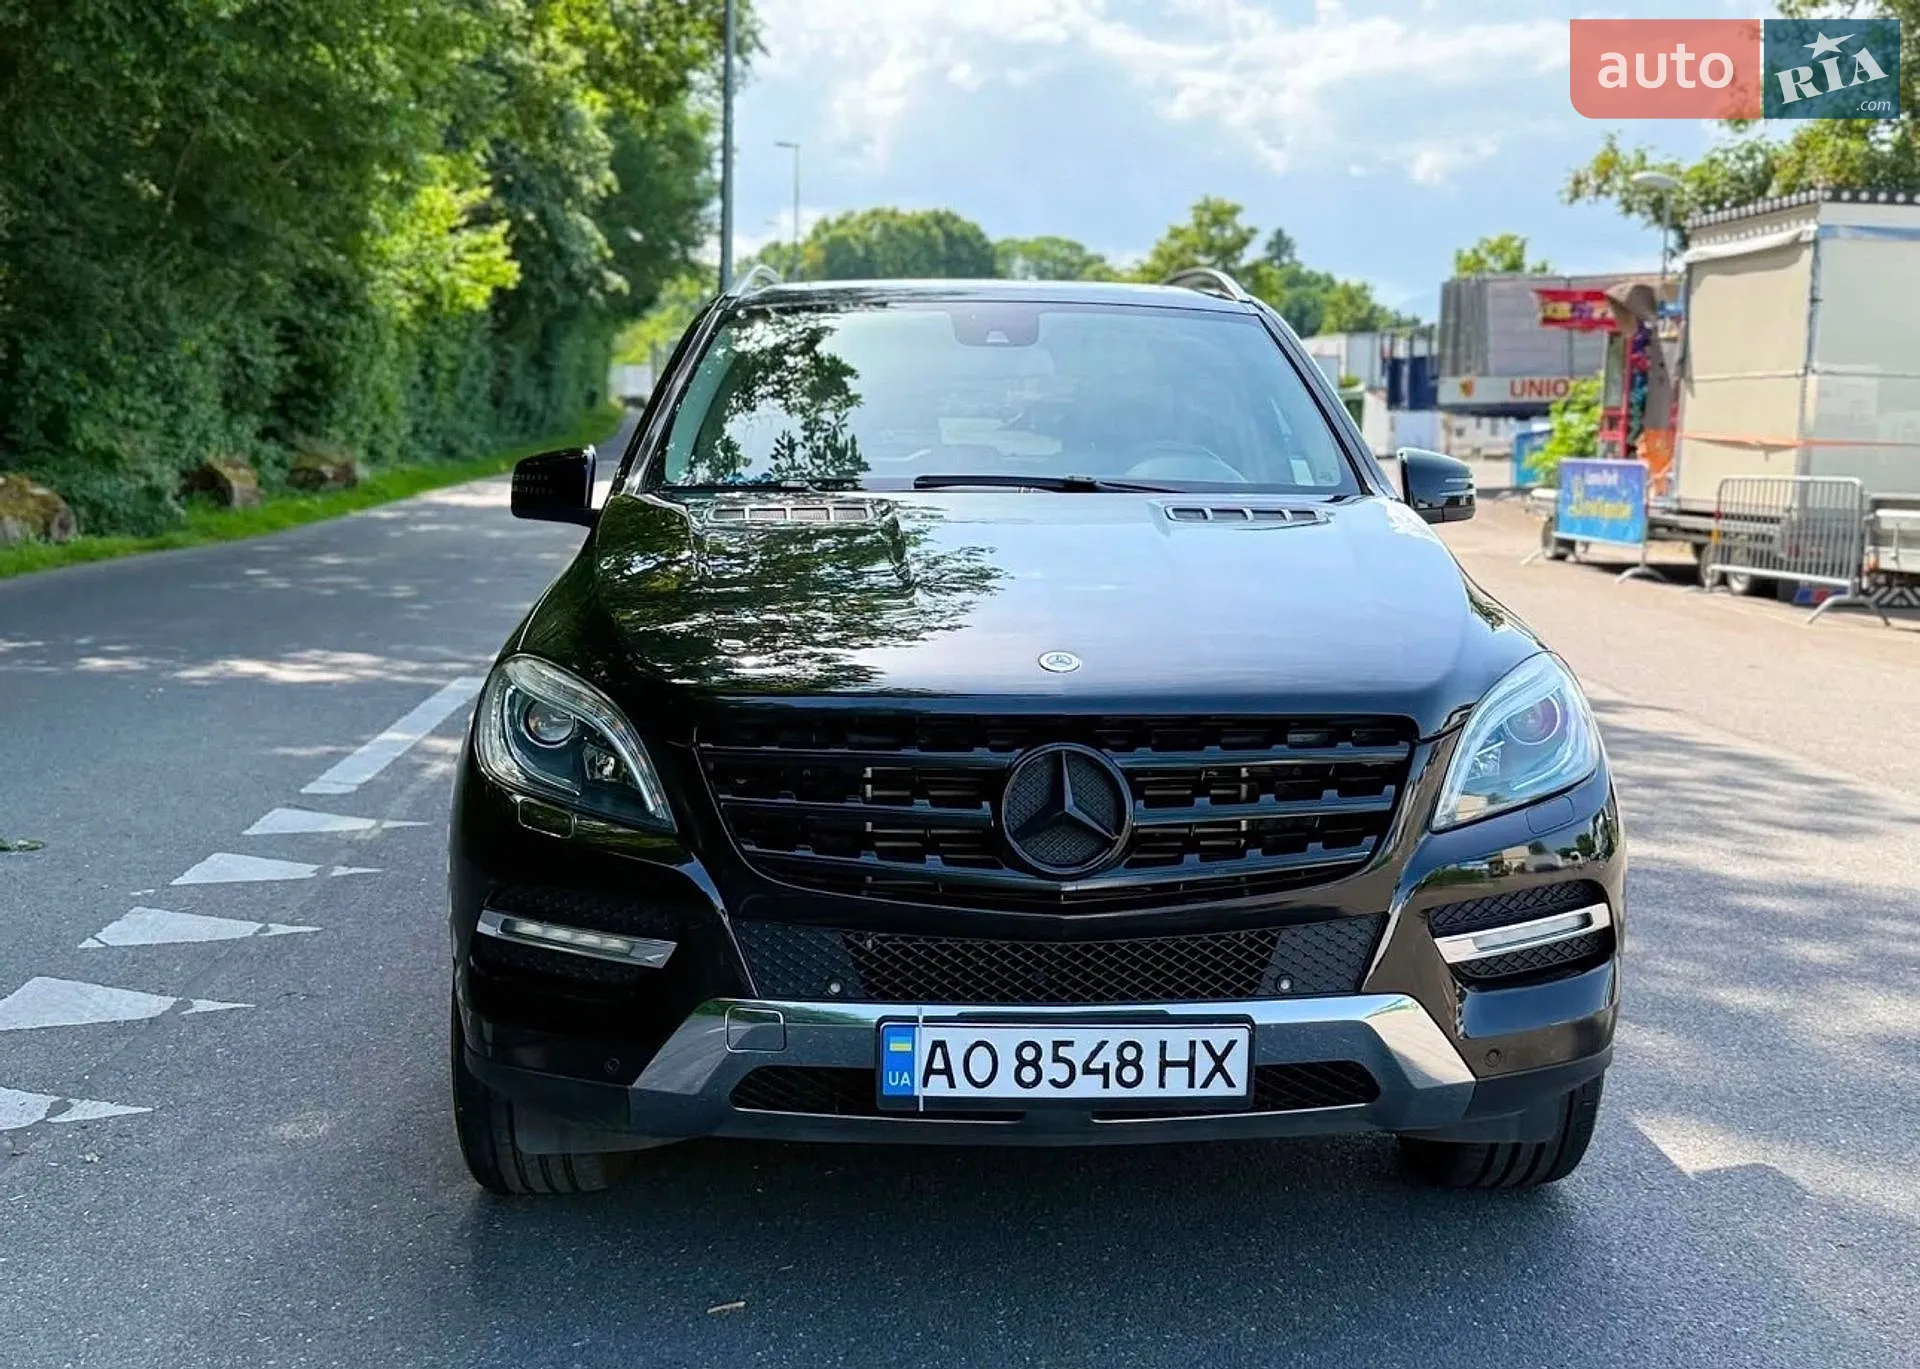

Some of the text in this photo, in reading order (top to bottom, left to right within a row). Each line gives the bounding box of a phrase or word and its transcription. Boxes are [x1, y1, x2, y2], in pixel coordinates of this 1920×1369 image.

[888, 1071, 912, 1087] UA
[922, 1039, 1238, 1089] AO 8548 HX
